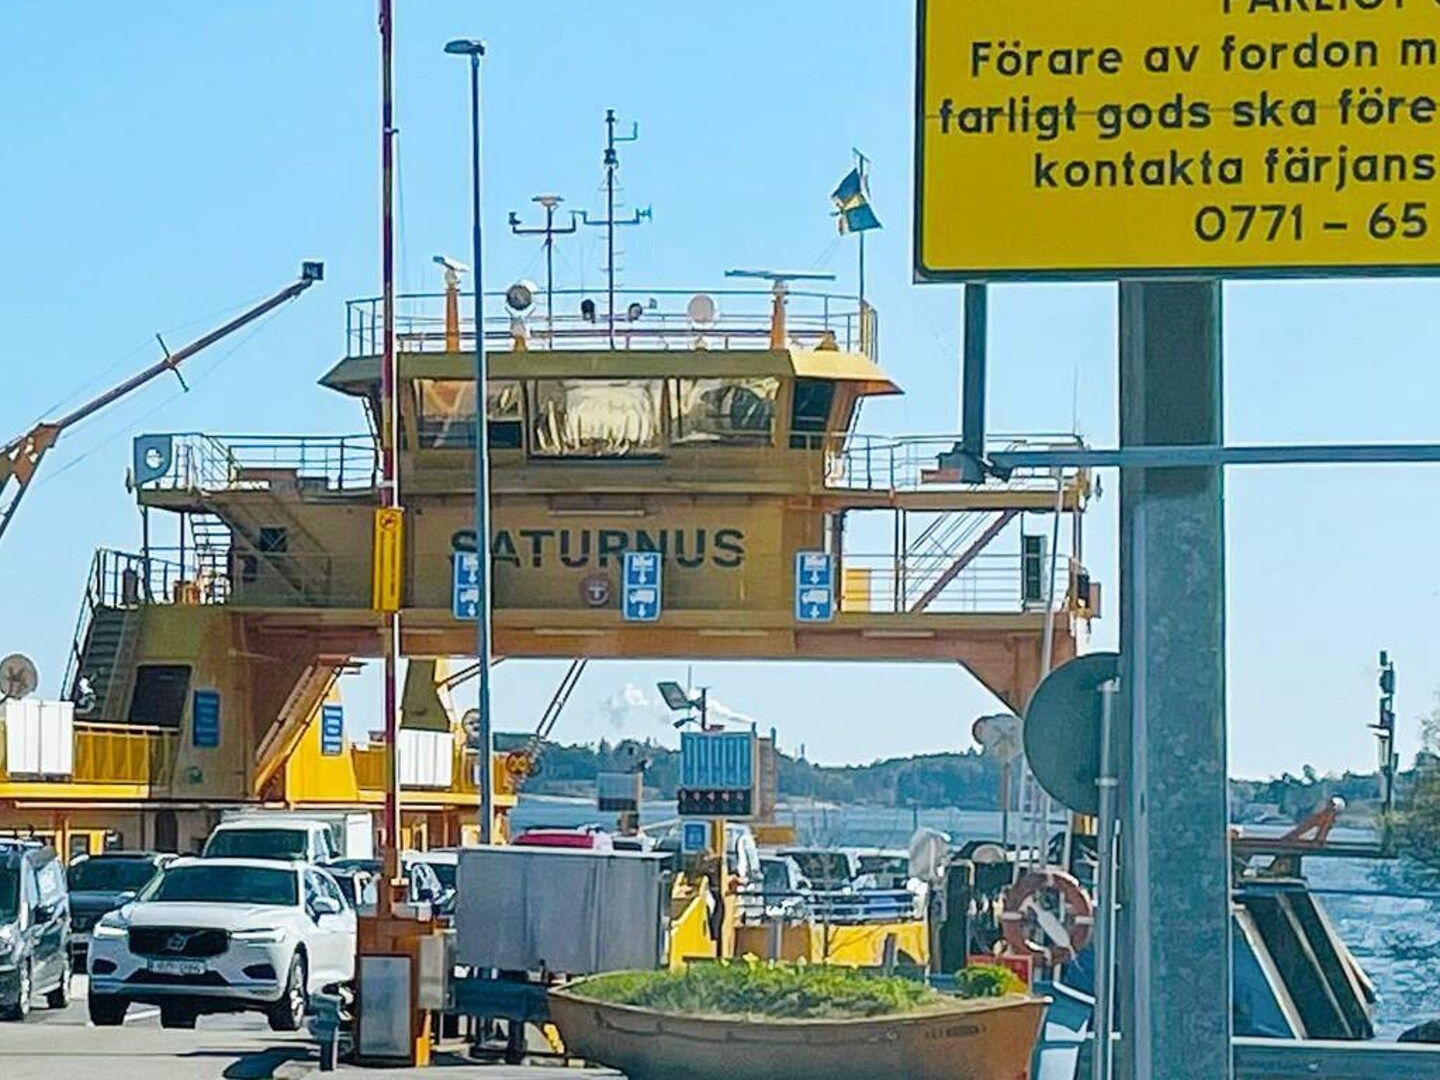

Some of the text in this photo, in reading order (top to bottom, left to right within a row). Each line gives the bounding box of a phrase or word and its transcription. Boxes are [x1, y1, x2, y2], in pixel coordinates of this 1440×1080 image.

[970, 39, 1124, 78] Förare
[1143, 44, 1201, 73] av
[1220, 31, 1379, 71] fordon
[938, 86, 1437, 141] farligt gods ska före
[1034, 144, 1437, 192] kontakta färjans
[1193, 203, 1303, 243] 0771
[1367, 201, 1428, 240] 65
